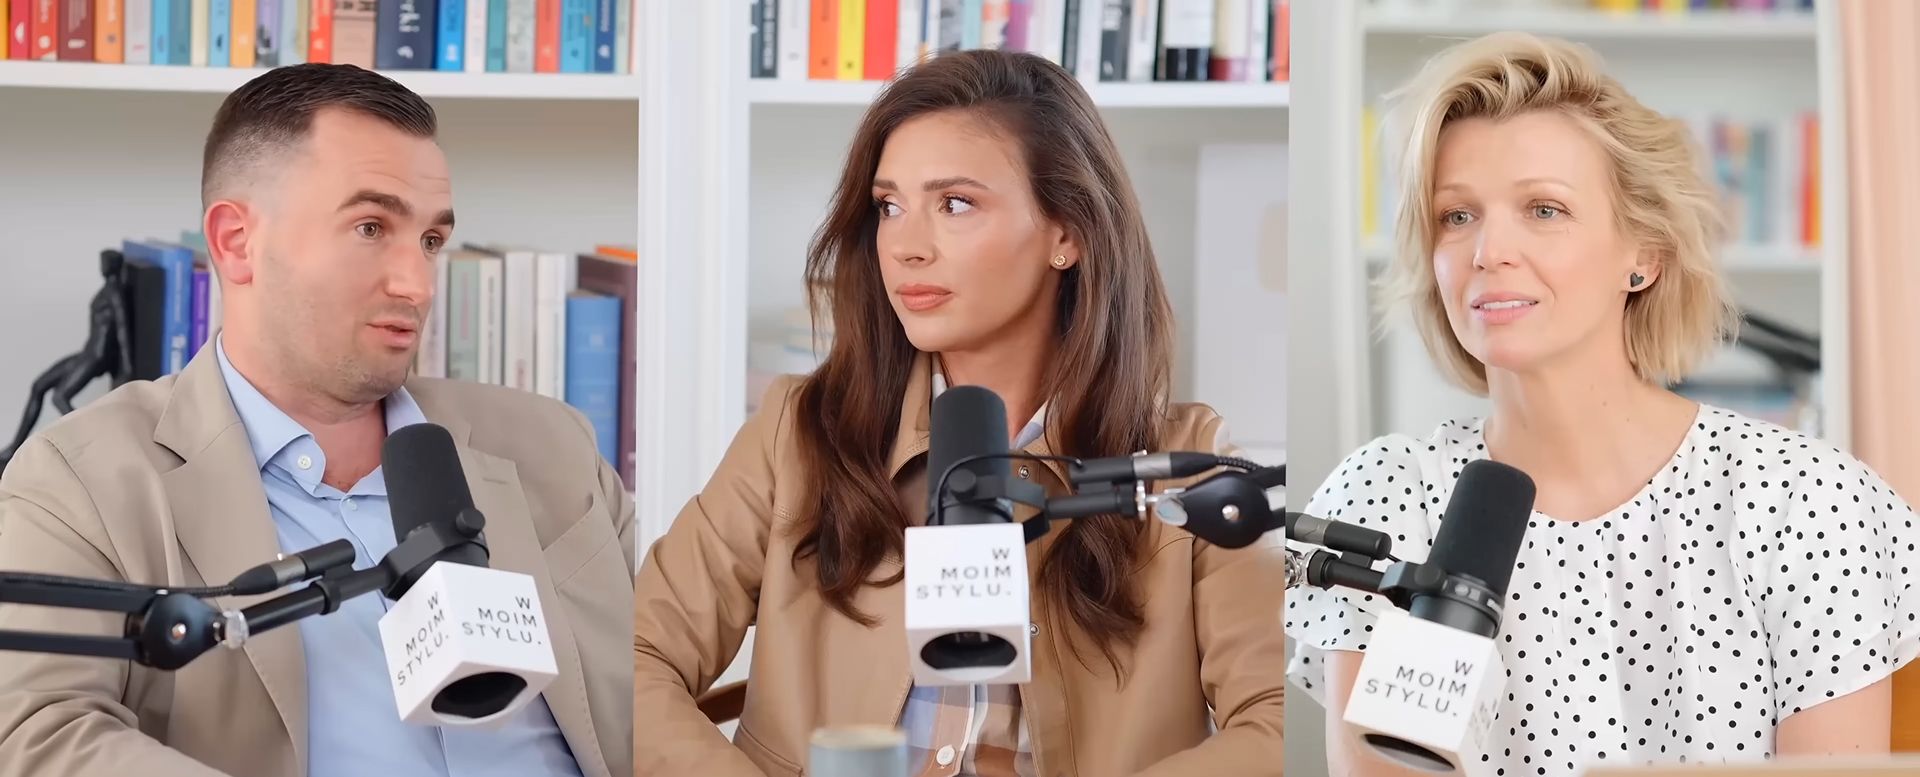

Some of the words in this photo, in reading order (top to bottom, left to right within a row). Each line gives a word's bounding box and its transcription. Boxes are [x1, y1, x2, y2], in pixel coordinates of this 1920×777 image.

[992, 548, 1010, 560] W
[941, 565, 1012, 580] MOIM
[427, 592, 439, 610] W
[916, 584, 1012, 600] STYLU.
[515, 595, 531, 610] W
[478, 607, 537, 627] MOIM
[406, 609, 445, 656] MOIM
[462, 622, 542, 645] STYLU.
[397, 633, 449, 686] STYLU.
[1454, 660, 1473, 676] W
[1396, 665, 1467, 697] MOIM
[1365, 678, 1458, 717] STYLU.
